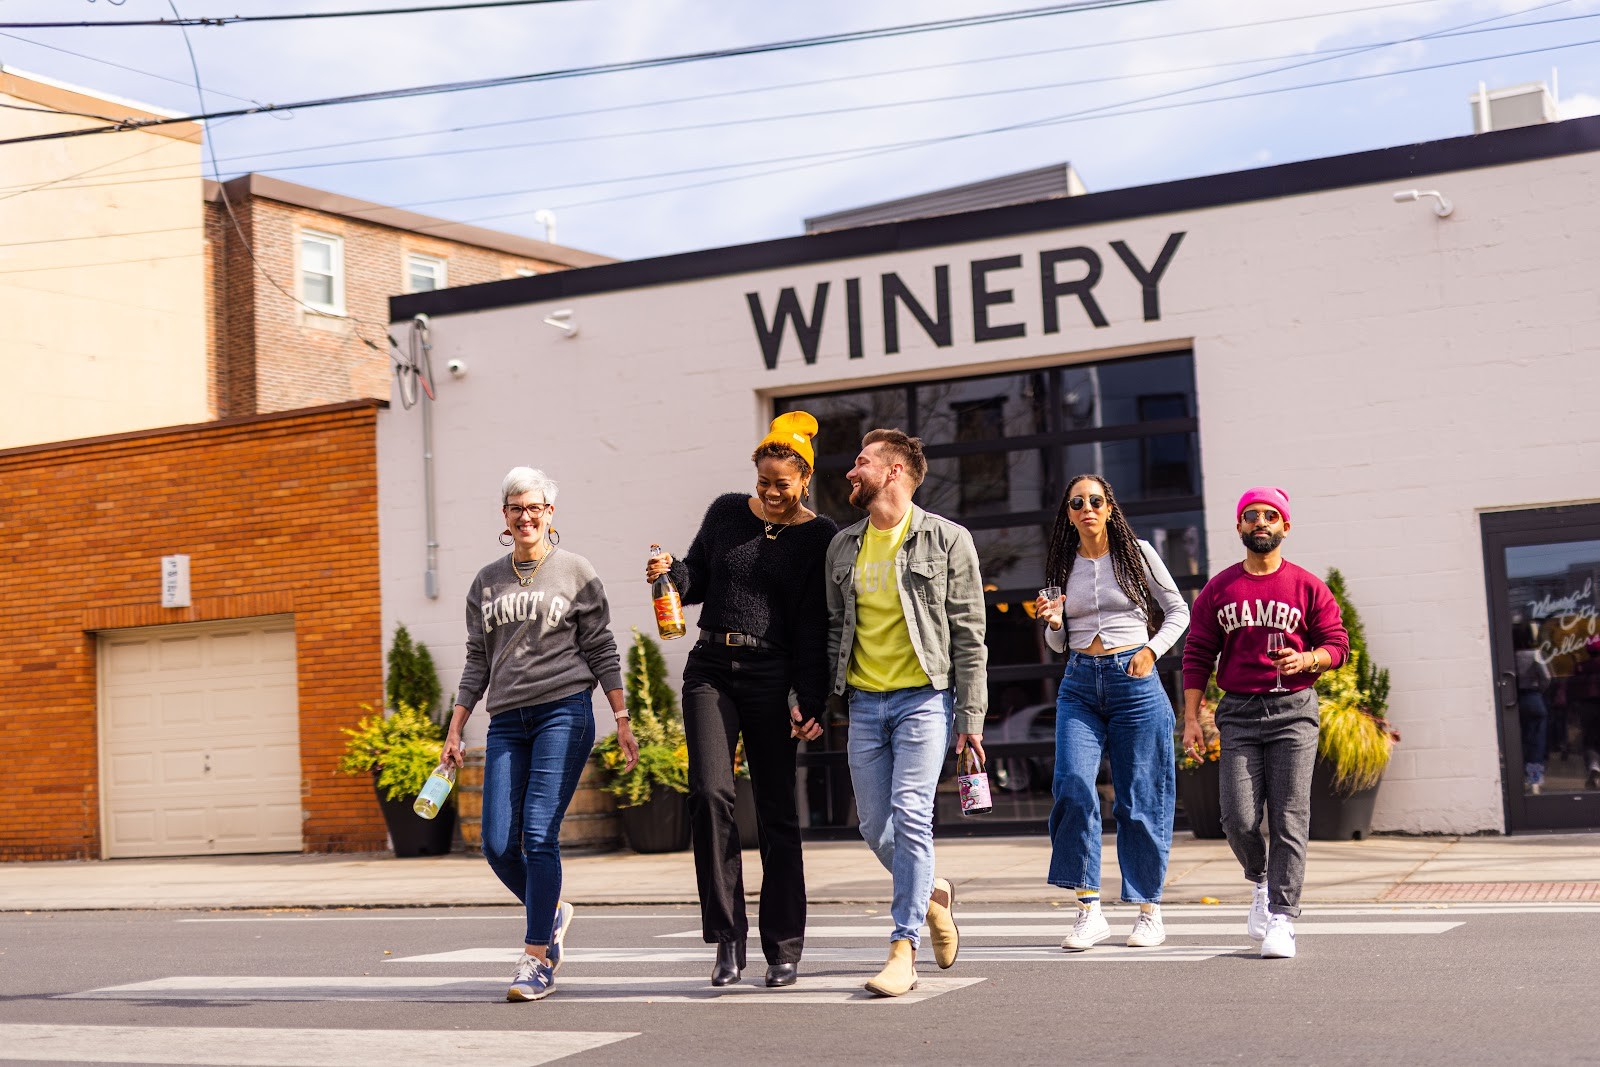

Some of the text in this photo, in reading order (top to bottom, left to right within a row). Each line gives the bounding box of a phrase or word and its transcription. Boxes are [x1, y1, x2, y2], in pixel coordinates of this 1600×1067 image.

[745, 231, 1187, 370] WINERY
[482, 591, 564, 633] PINOT G
[1217, 599, 1301, 634] CHAMBO
[1527, 577, 1591, 619] Mural
[1560, 605, 1599, 635] City
[1534, 633, 1600, 665] Cellars
